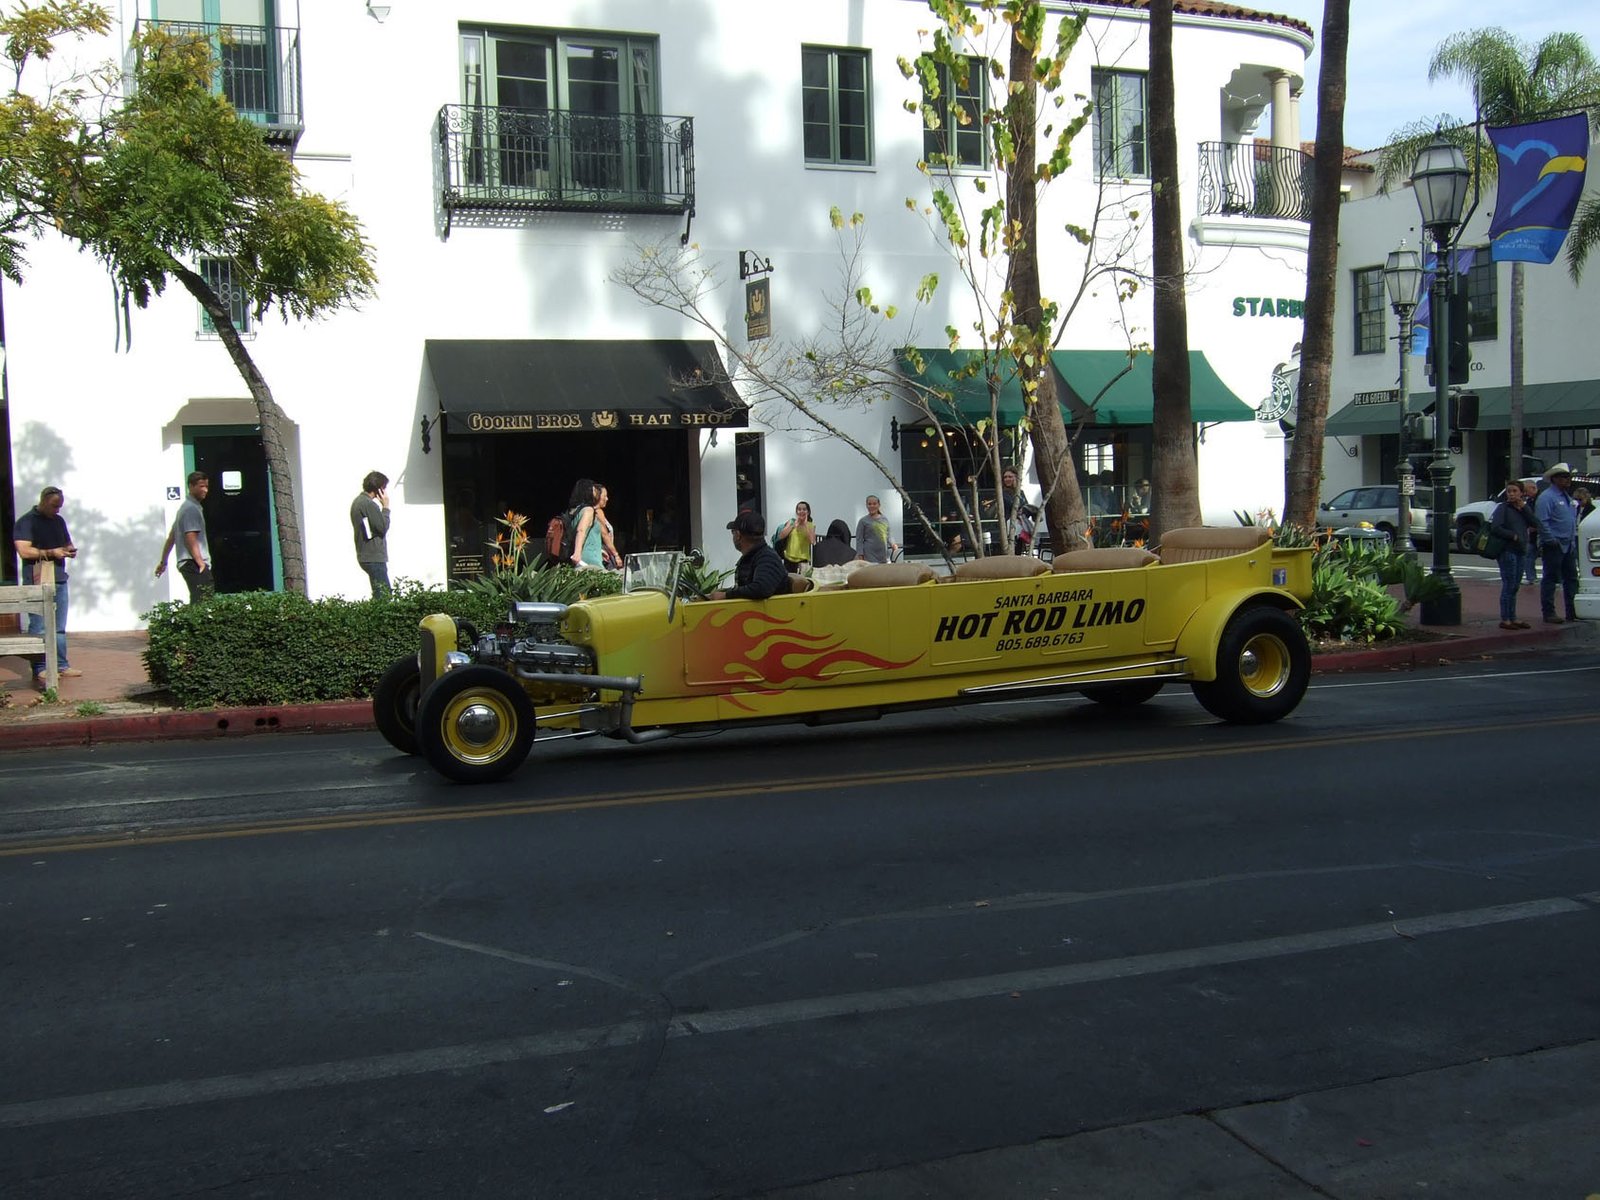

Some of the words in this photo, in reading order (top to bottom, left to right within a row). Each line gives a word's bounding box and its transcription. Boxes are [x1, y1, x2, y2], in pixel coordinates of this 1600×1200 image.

[468, 412, 533, 431] GOORIN
[629, 414, 671, 425] HAT
[680, 413, 732, 425] SHOP
[994, 594, 1034, 609] SANTA
[1036, 588, 1094, 605] BARBARA
[934, 611, 1000, 643] HOT
[1002, 605, 1067, 636] ROD
[1071, 598, 1146, 629] LIMO
[995, 632, 1085, 652] 805.689.6763
